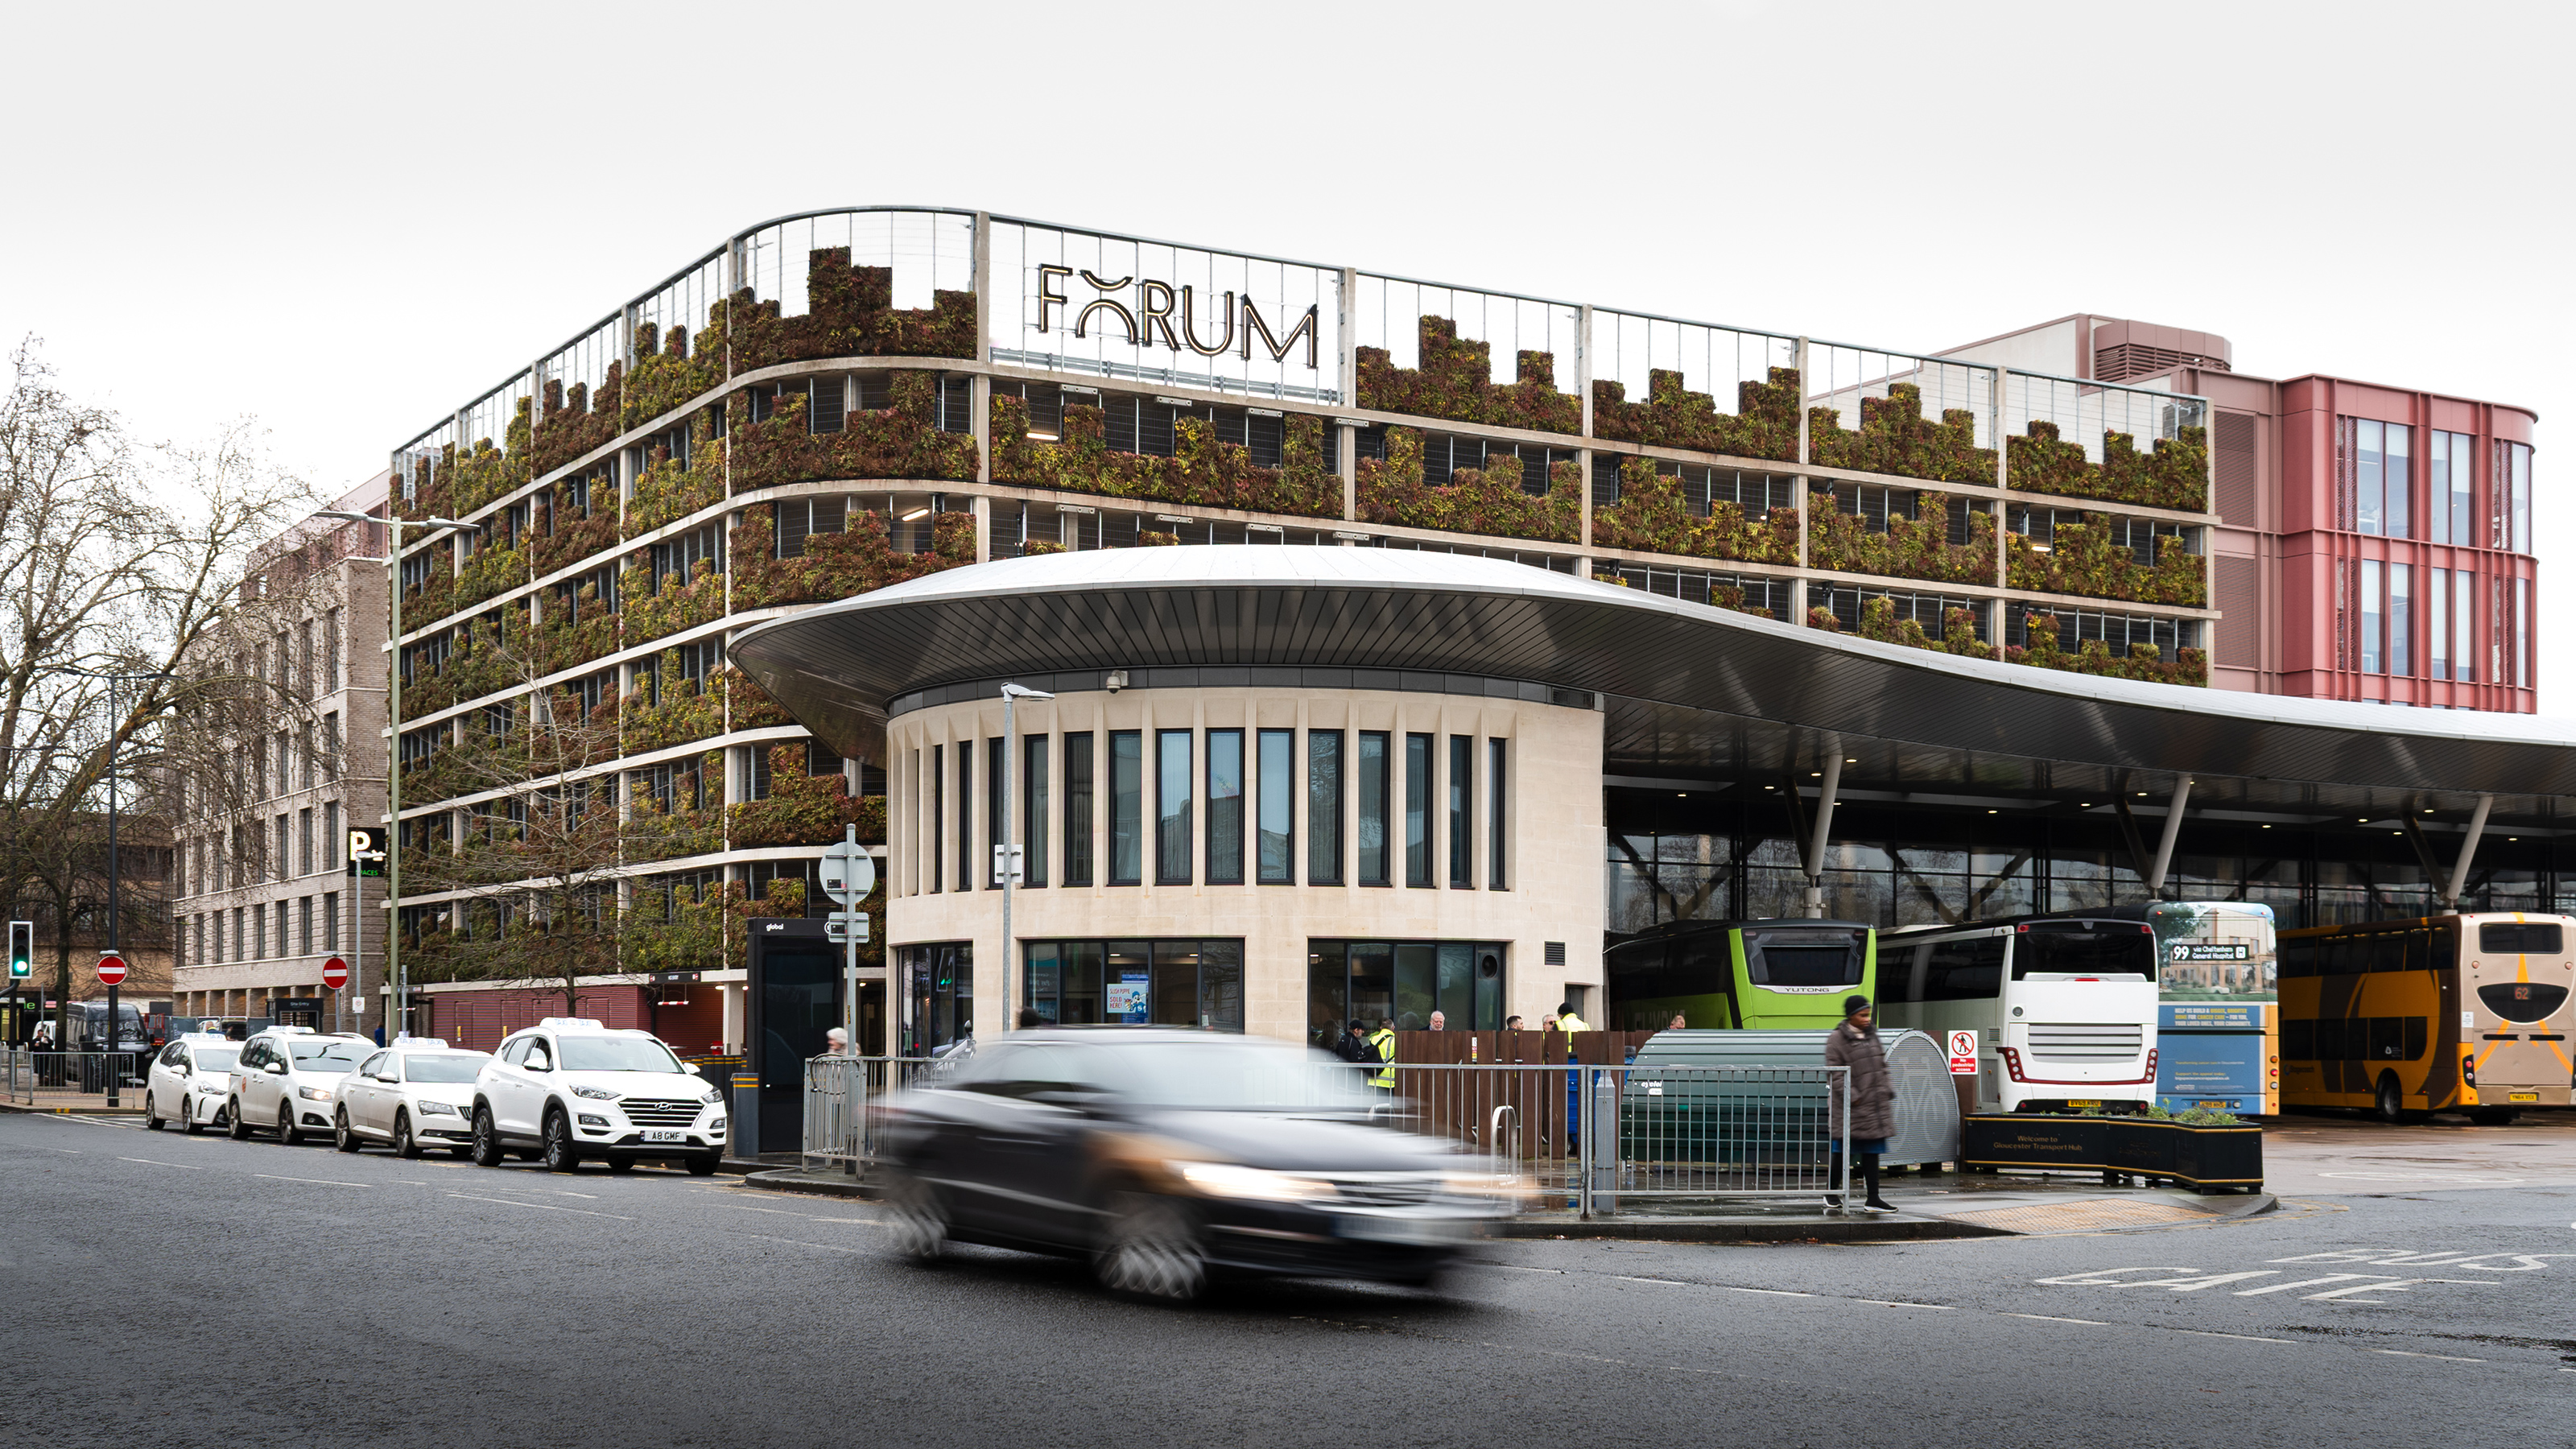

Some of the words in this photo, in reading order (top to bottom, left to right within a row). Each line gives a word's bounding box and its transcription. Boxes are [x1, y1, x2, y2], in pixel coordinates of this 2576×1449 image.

[1038, 263, 1318, 369] FORUM
[350, 831, 371, 861] P
[766, 923, 784, 932] global
[2174, 945, 2190, 960] 99
[2515, 987, 2529, 999] 62
[652, 1132, 662, 1140] A8
[2265, 1248, 2576, 1271] BUS
[2034, 1267, 2501, 1303] GATE
